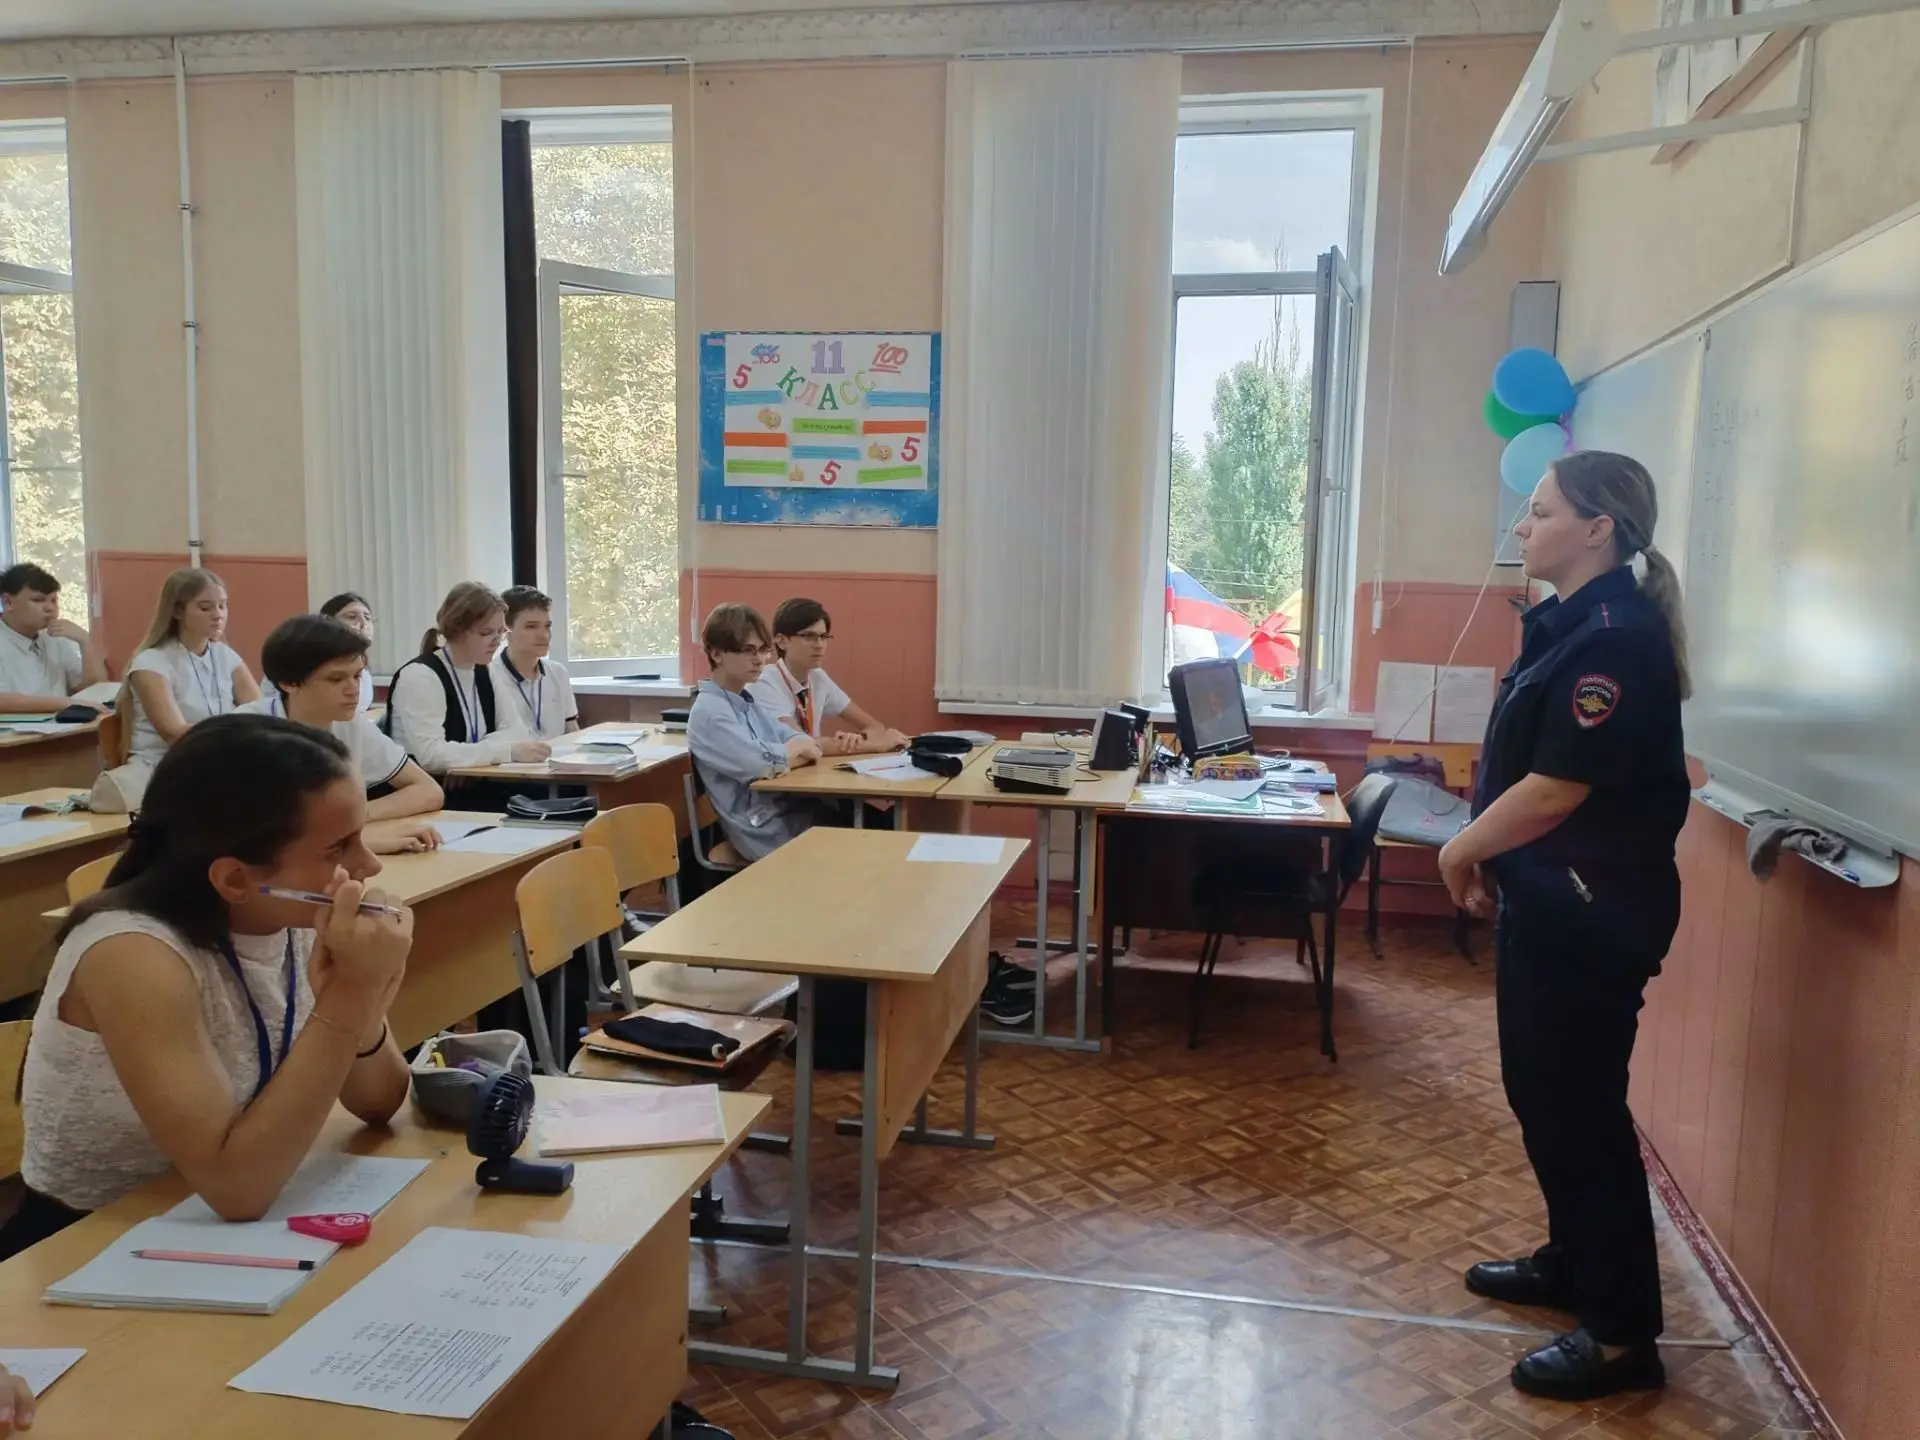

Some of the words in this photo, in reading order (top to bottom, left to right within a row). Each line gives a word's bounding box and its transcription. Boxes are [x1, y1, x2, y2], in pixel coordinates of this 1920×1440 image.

[811, 340, 845, 374] 11
[871, 342, 909, 366] 100
[732, 363, 752, 389] 5
[776, 366, 876, 410] КЛАСС
[900, 436, 921, 462] 5
[820, 460, 842, 485] 5
